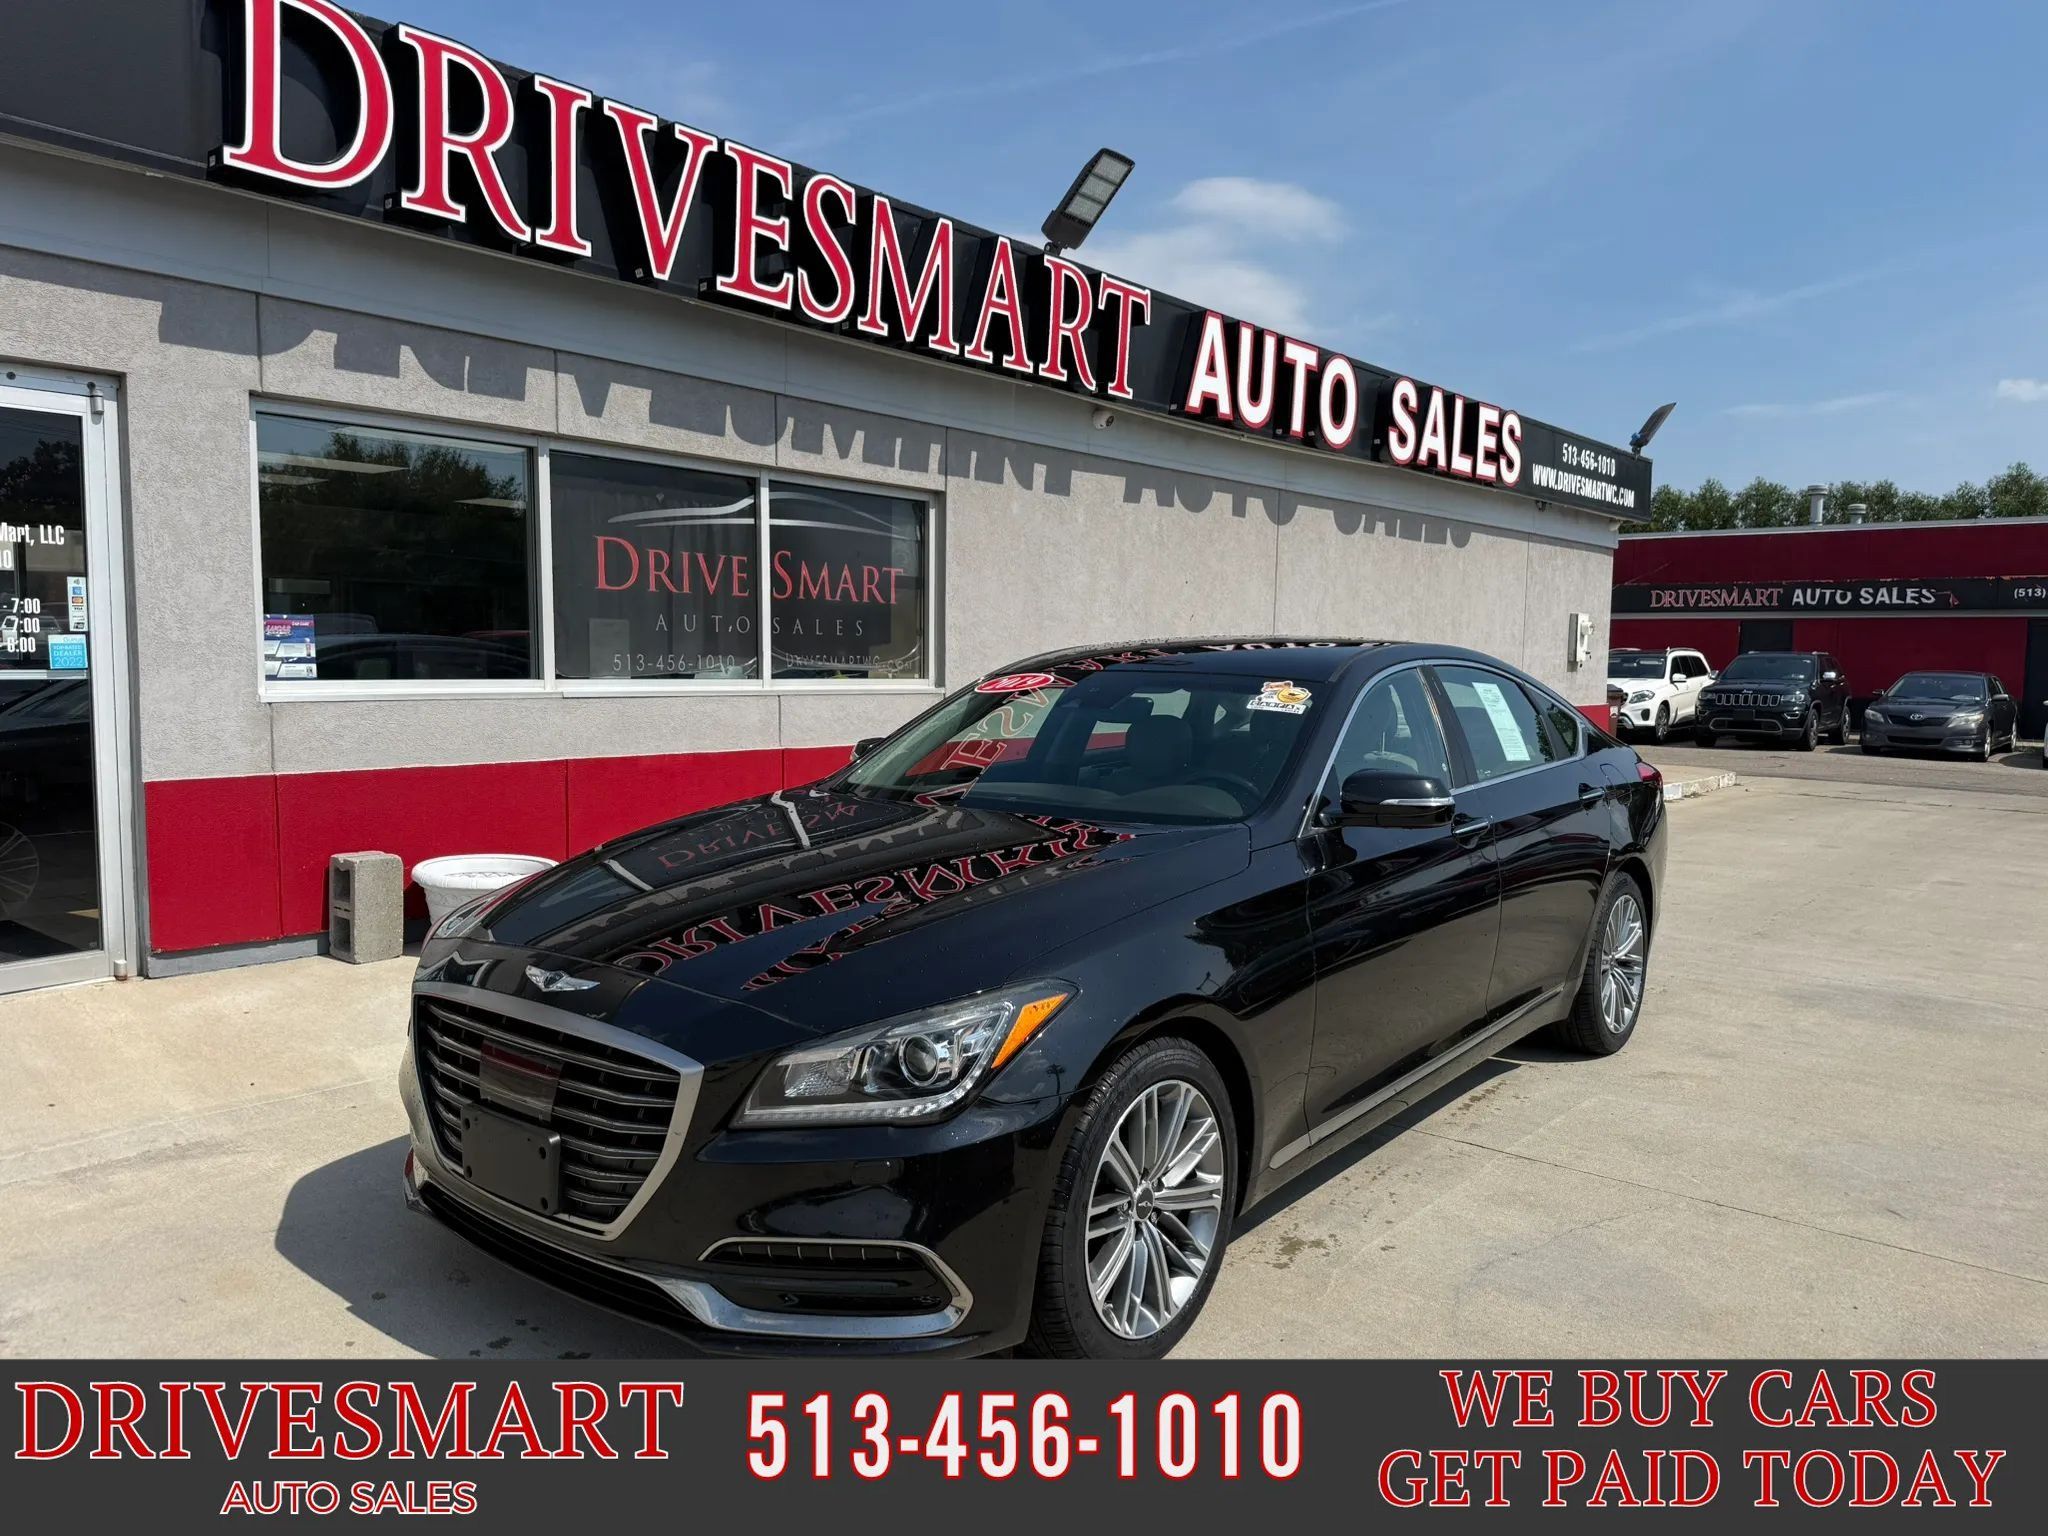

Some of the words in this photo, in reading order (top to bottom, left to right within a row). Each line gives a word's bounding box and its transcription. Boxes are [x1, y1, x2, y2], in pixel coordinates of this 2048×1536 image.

[223, 0, 1151, 400] DRIVESMART
[1185, 309, 1359, 450] AUTO
[1388, 376, 1523, 488] SALES
[1562, 442, 1616, 477] 513-456-1010
[1532, 463, 1635, 508] WWW.DRIVESMARTWC.COM
[40, 524, 65, 545] LLC
[594, 535, 751, 597] DRIVE
[772, 550, 904, 605] SMART
[1650, 587, 1783, 608] DRIVESMART
[1792, 588, 1852, 606] AUTO
[1859, 587, 1936, 605] SALES
[2014, 588, 2047, 599] (513)
[655, 613, 750, 633] AUTO
[772, 617, 863, 637] SALES
[54, 656, 83, 667] 2022
